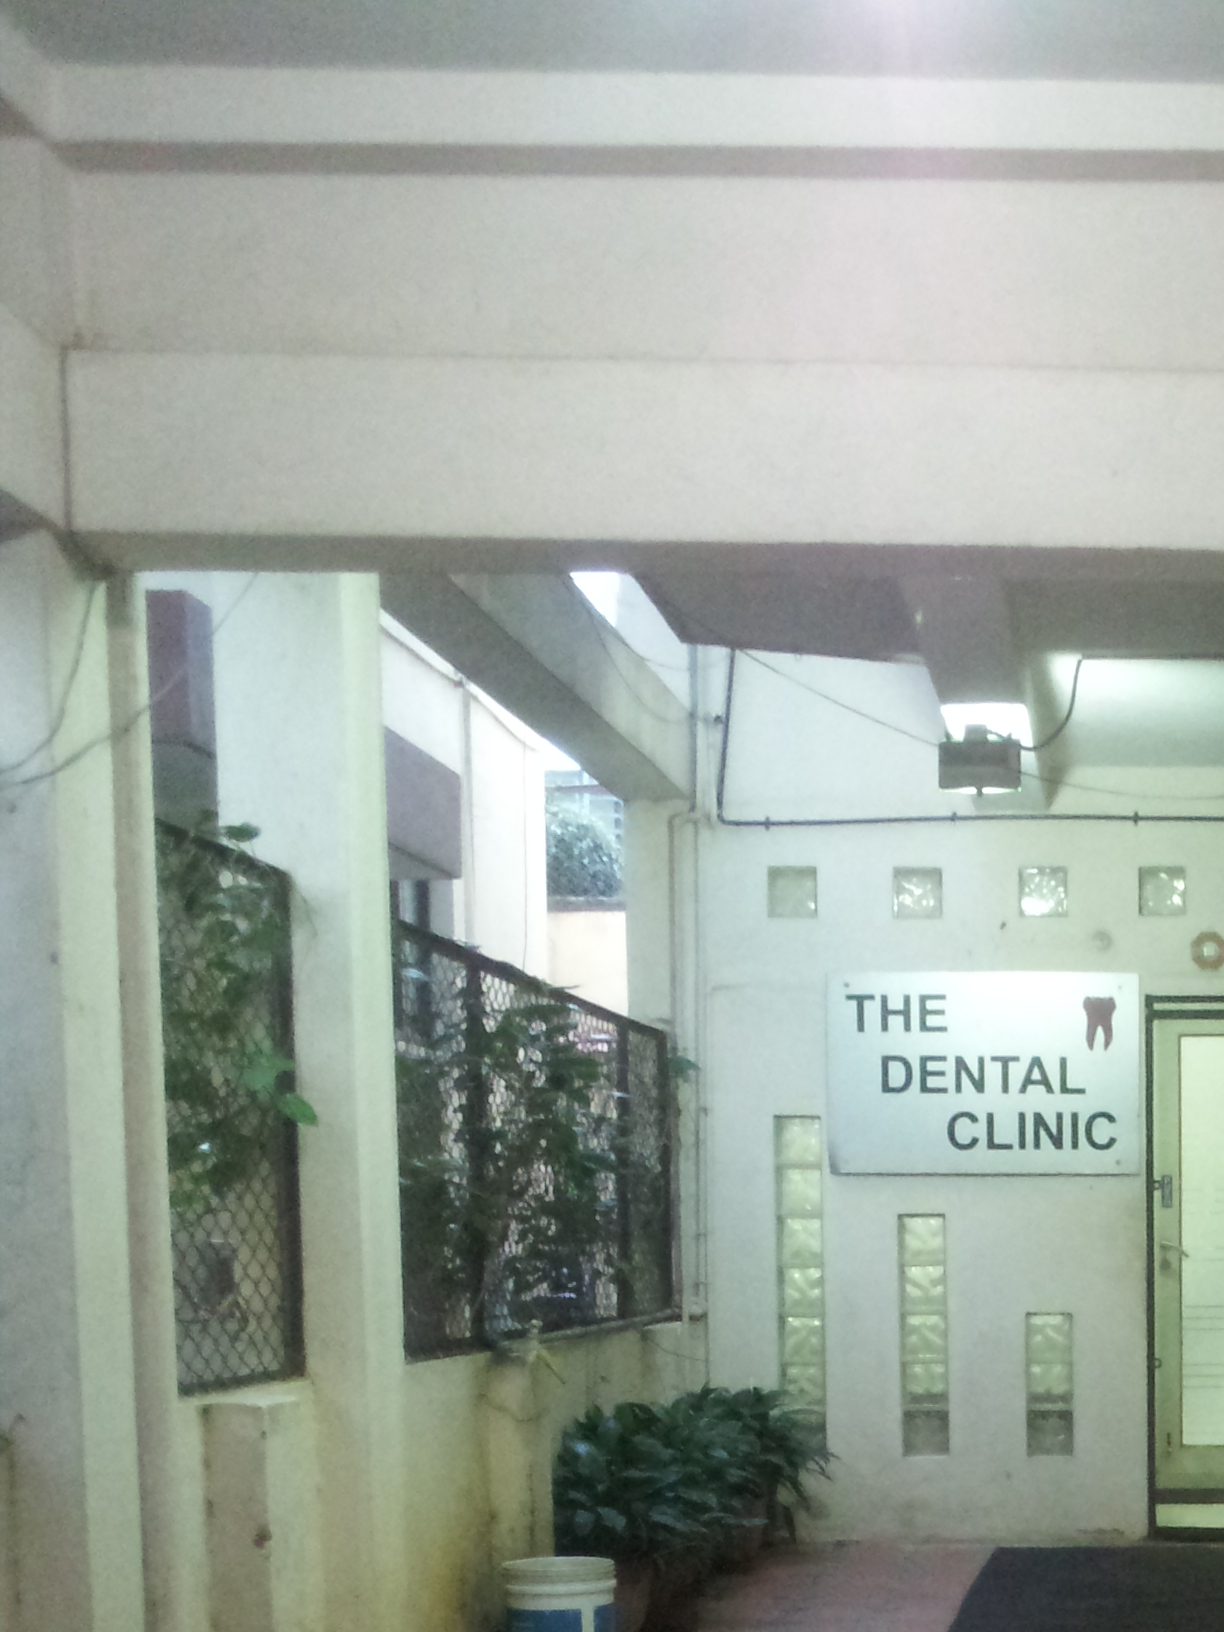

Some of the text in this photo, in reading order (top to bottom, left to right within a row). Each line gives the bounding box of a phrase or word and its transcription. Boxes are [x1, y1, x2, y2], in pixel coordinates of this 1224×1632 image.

[845, 993, 948, 1032] THE
[880, 1055, 1087, 1094] DENTAL
[947, 1110, 1118, 1151] CLINIC
